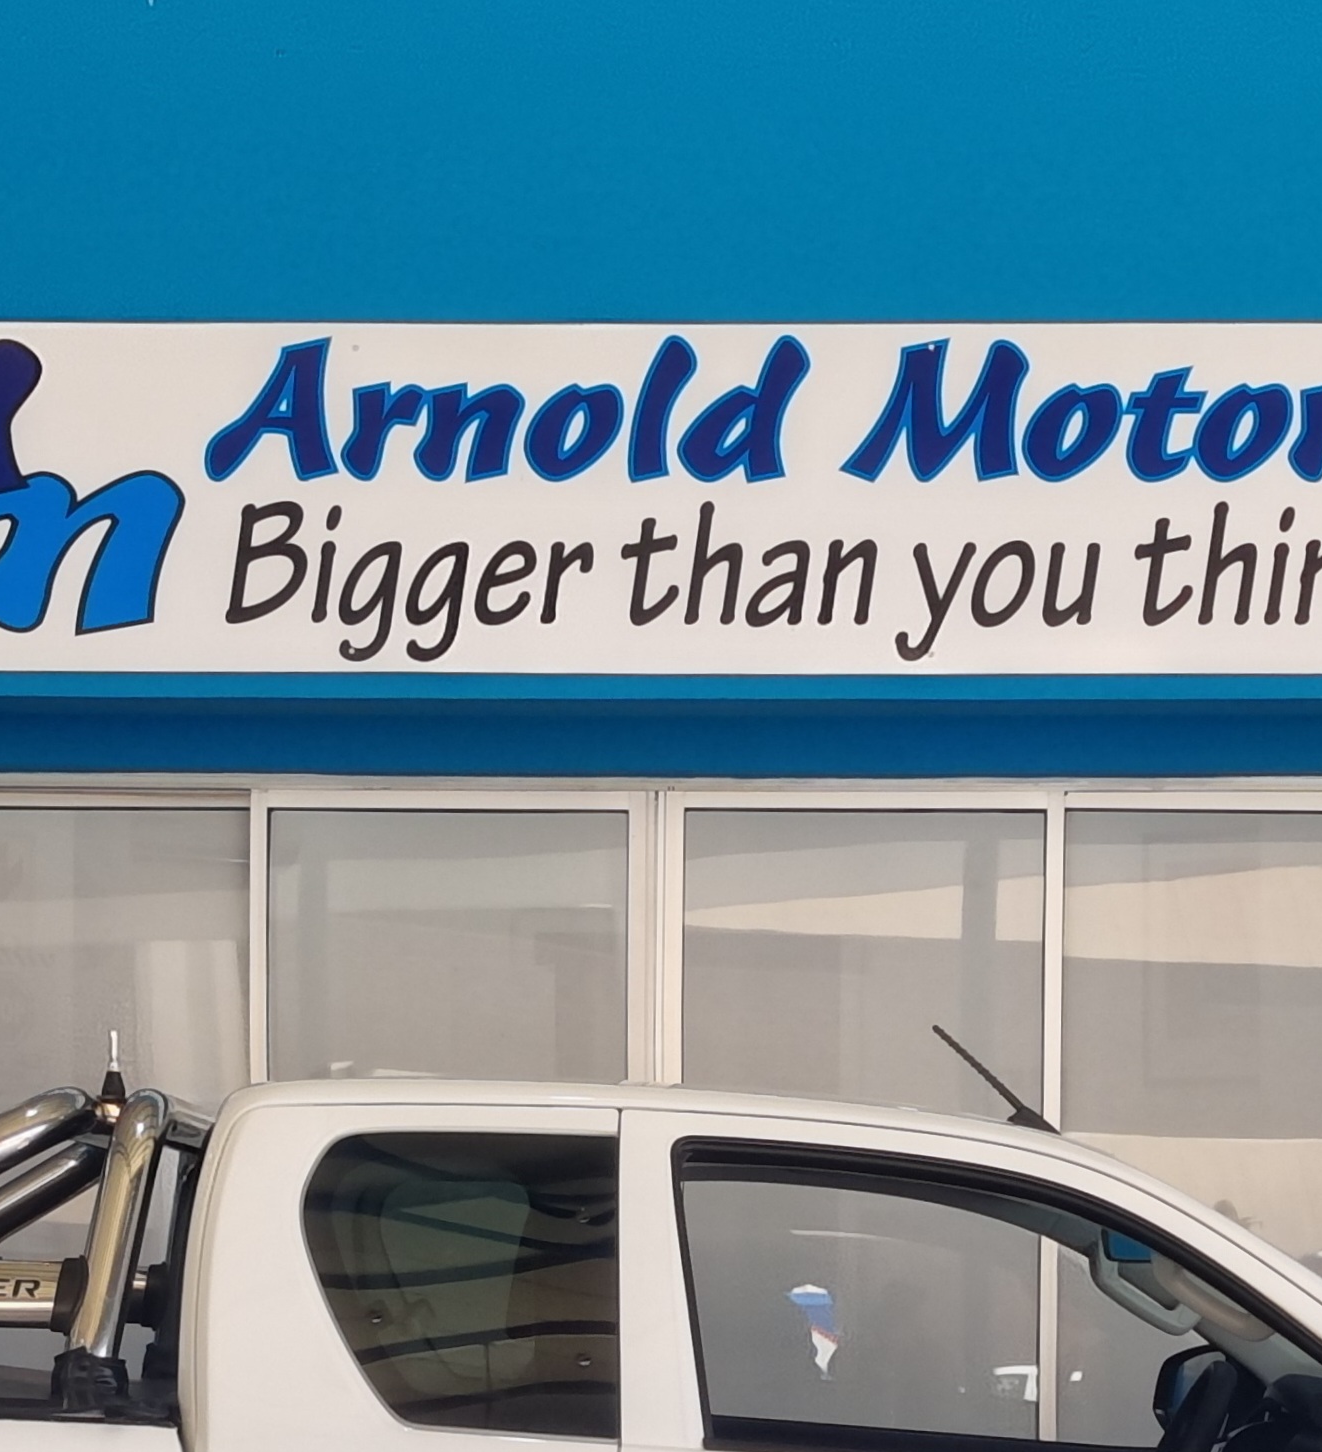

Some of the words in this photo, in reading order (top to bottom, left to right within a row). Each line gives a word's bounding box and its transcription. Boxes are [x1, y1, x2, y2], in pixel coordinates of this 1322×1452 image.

[204, 334, 811, 484] Arnold
[225, 501, 593, 662] Bigger
[621, 501, 878, 628] than
[894, 540, 1101, 662] you
